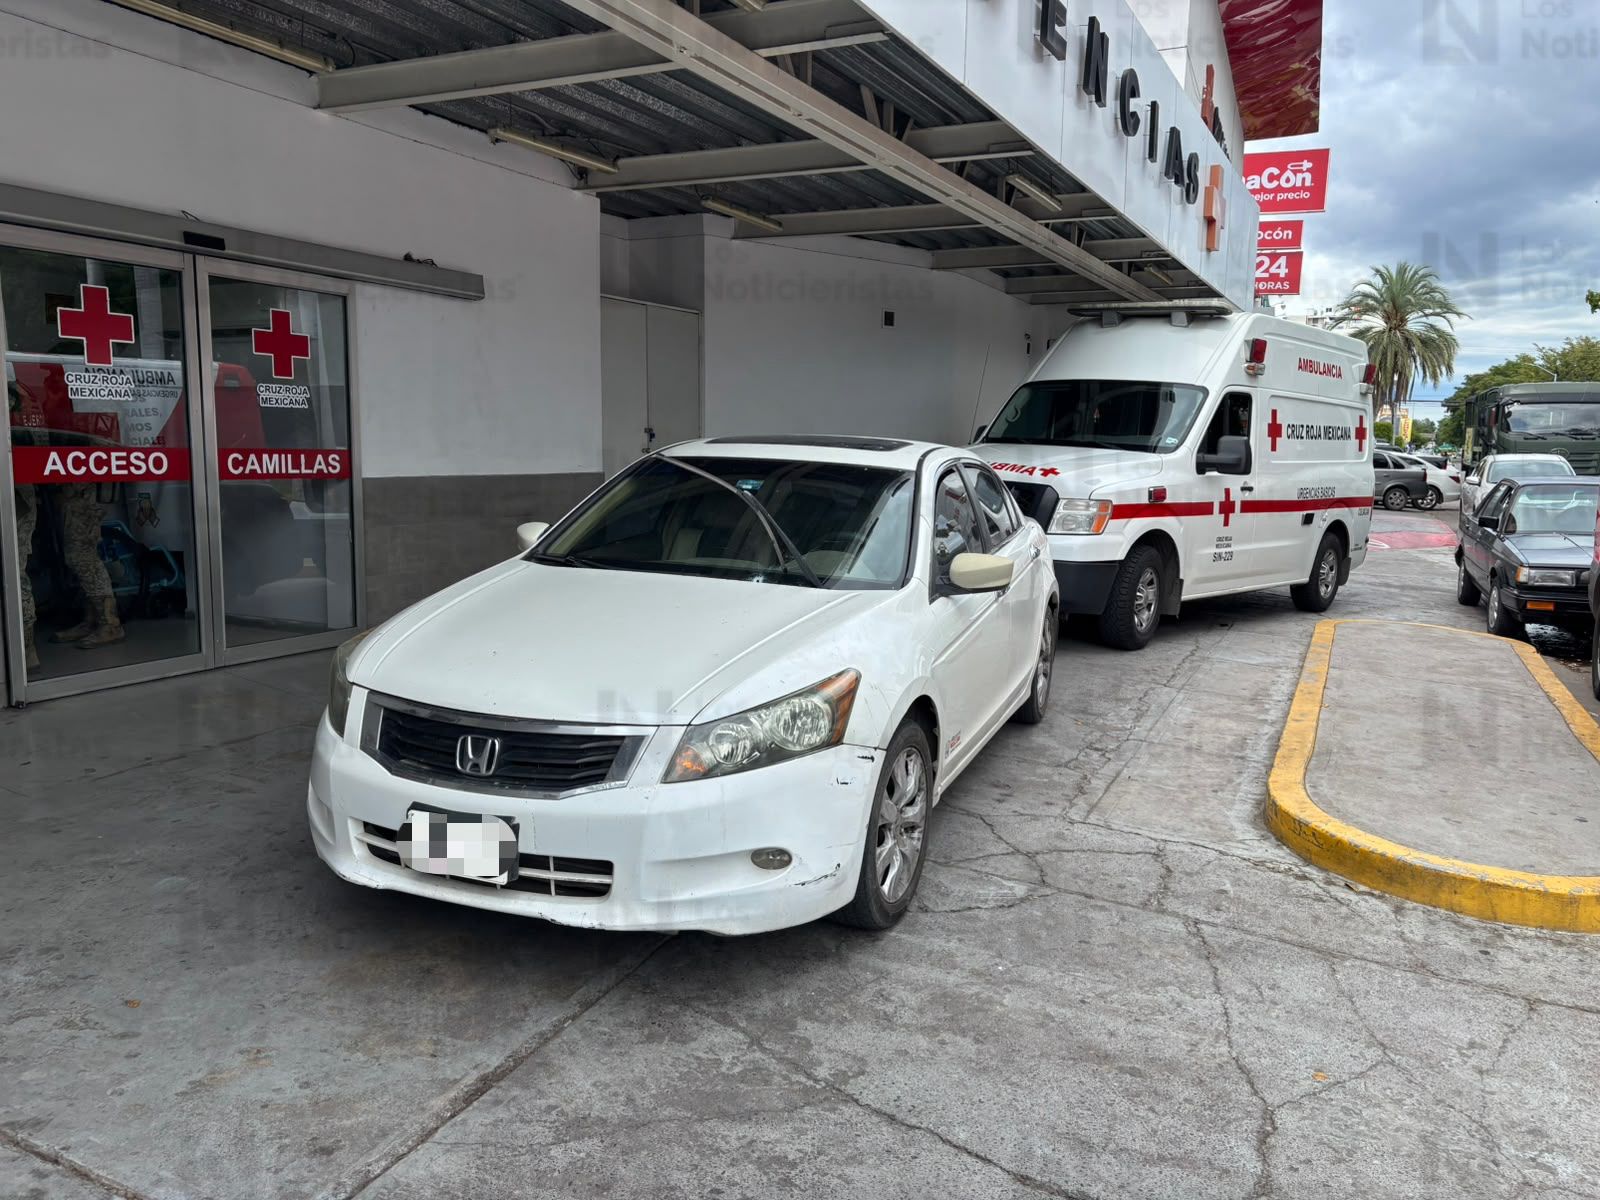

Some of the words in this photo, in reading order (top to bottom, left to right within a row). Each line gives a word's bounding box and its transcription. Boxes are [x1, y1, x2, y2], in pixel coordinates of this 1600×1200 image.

[1277, 191, 1310, 202] precio
[1255, 255, 1288, 278] 24
[1297, 357, 1342, 379] AMBULANCIA
[66, 373, 99, 385] CRUZ
[100, 375, 133, 387] ROJA
[69, 387, 131, 399] MEXICANA
[258, 384, 283, 395] CRUZ
[285, 386, 309, 396] ROJA
[260, 396, 307, 407] MEXICANA
[1286, 423, 1305, 440] CRUZ
[1306, 424, 1322, 440] ROJA
[1323, 425, 1352, 440] MEXICANA
[43, 451, 168, 476] ACCESO
[227, 453, 341, 475] CAMILLAS
